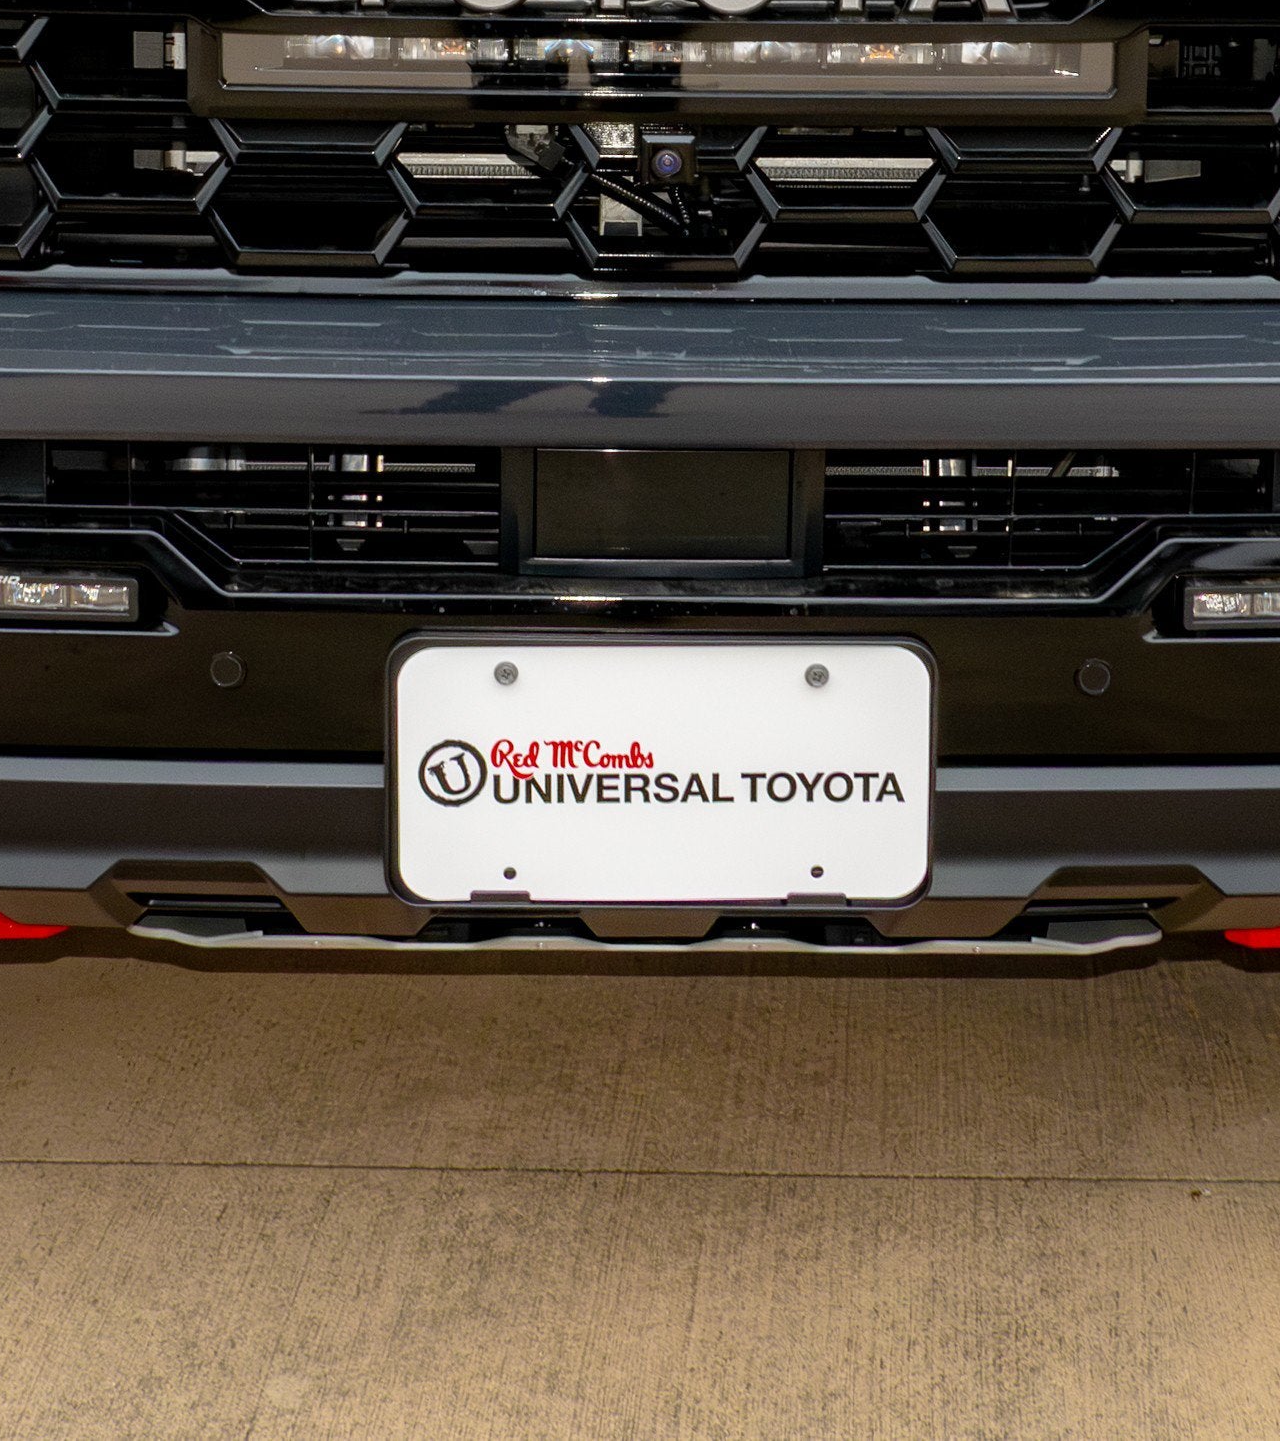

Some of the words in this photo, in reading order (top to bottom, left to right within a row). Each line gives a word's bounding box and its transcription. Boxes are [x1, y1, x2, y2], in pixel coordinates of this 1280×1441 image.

[490, 739, 540, 779] Red
[543, 739, 655, 770] McCombs
[492, 772, 734, 804] UNIVERSAL
[741, 772, 905, 804] TOYOTA
